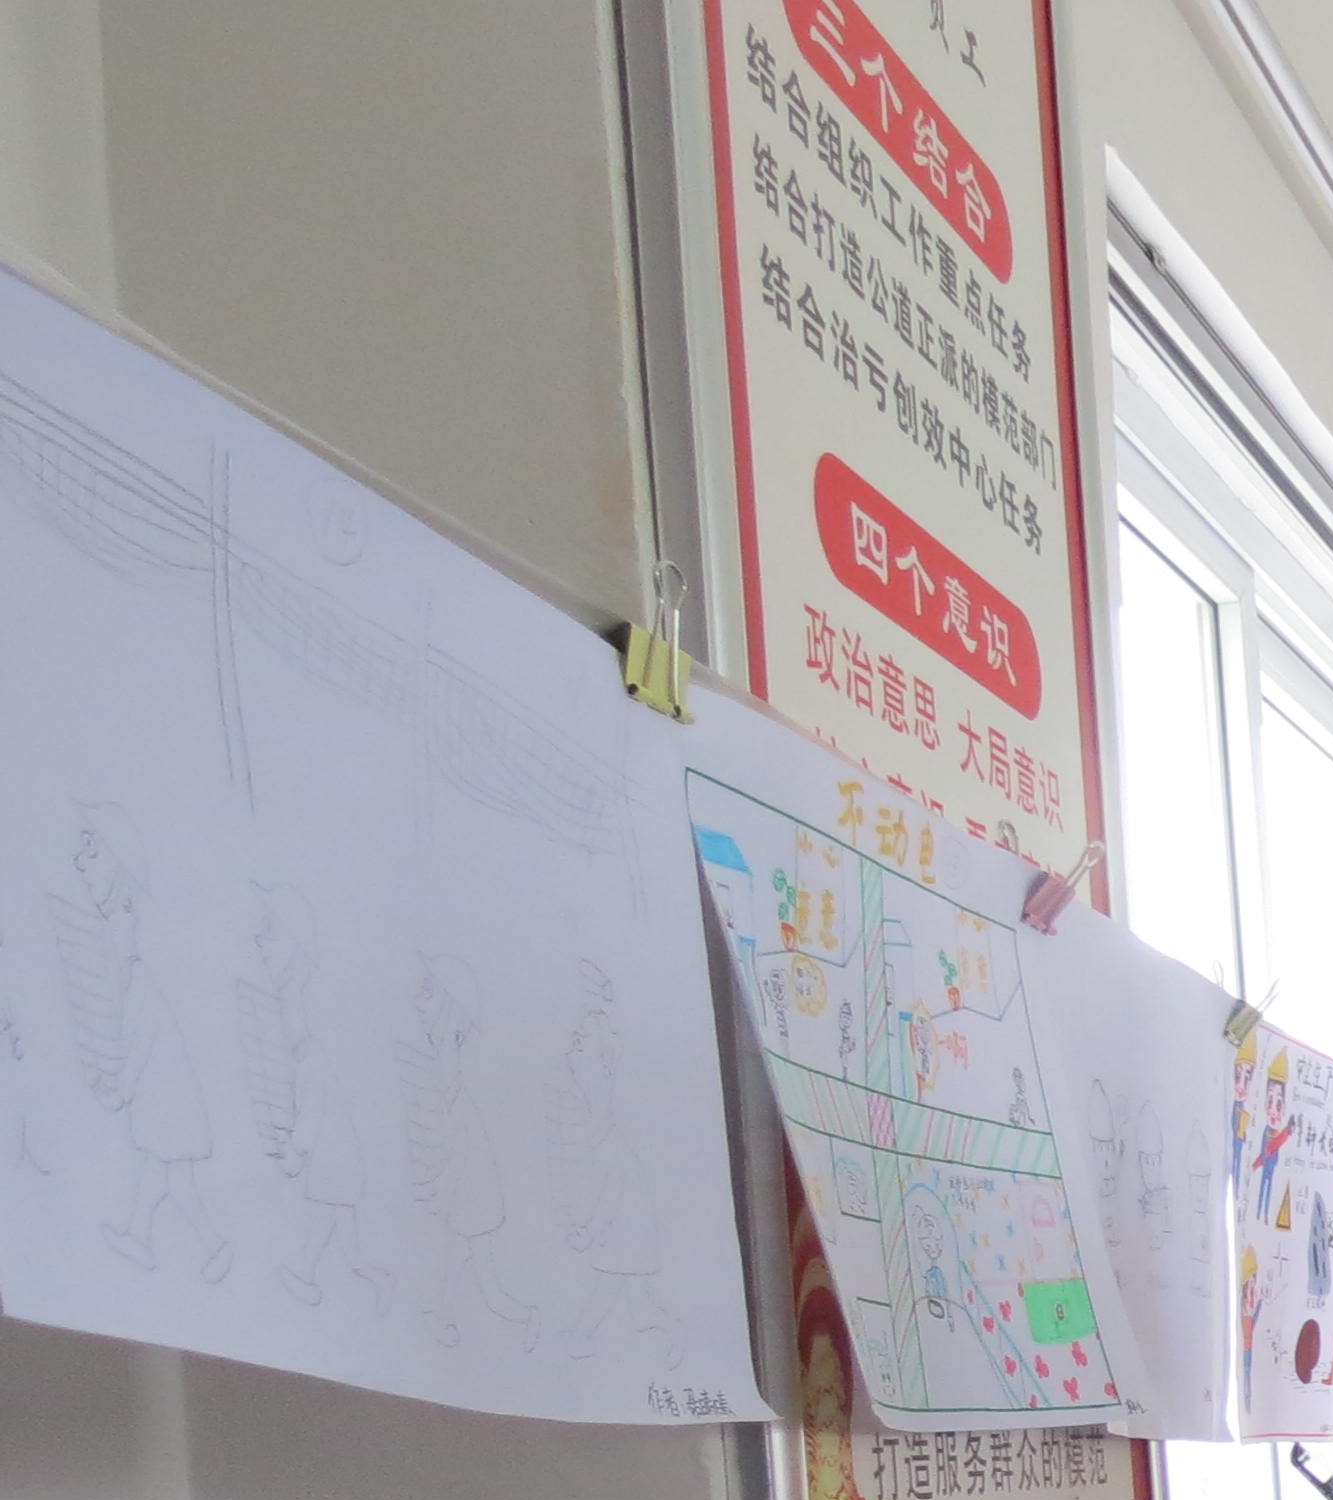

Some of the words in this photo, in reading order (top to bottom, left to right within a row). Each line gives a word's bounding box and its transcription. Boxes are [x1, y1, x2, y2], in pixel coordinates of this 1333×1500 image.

[745, 21, 1031, 385] 结合组织工作重点任务
[810, 1, 992, 244] 三个结合
[753, 133, 1058, 490] 结合打造公道正派的模范部门
[759, 243, 1043, 556] 结合治亏创效中心任务
[802, 602, 942, 752] 政治意思
[957, 708, 1065, 834] 大局意识
[850, 501, 1018, 687] 四个意识
